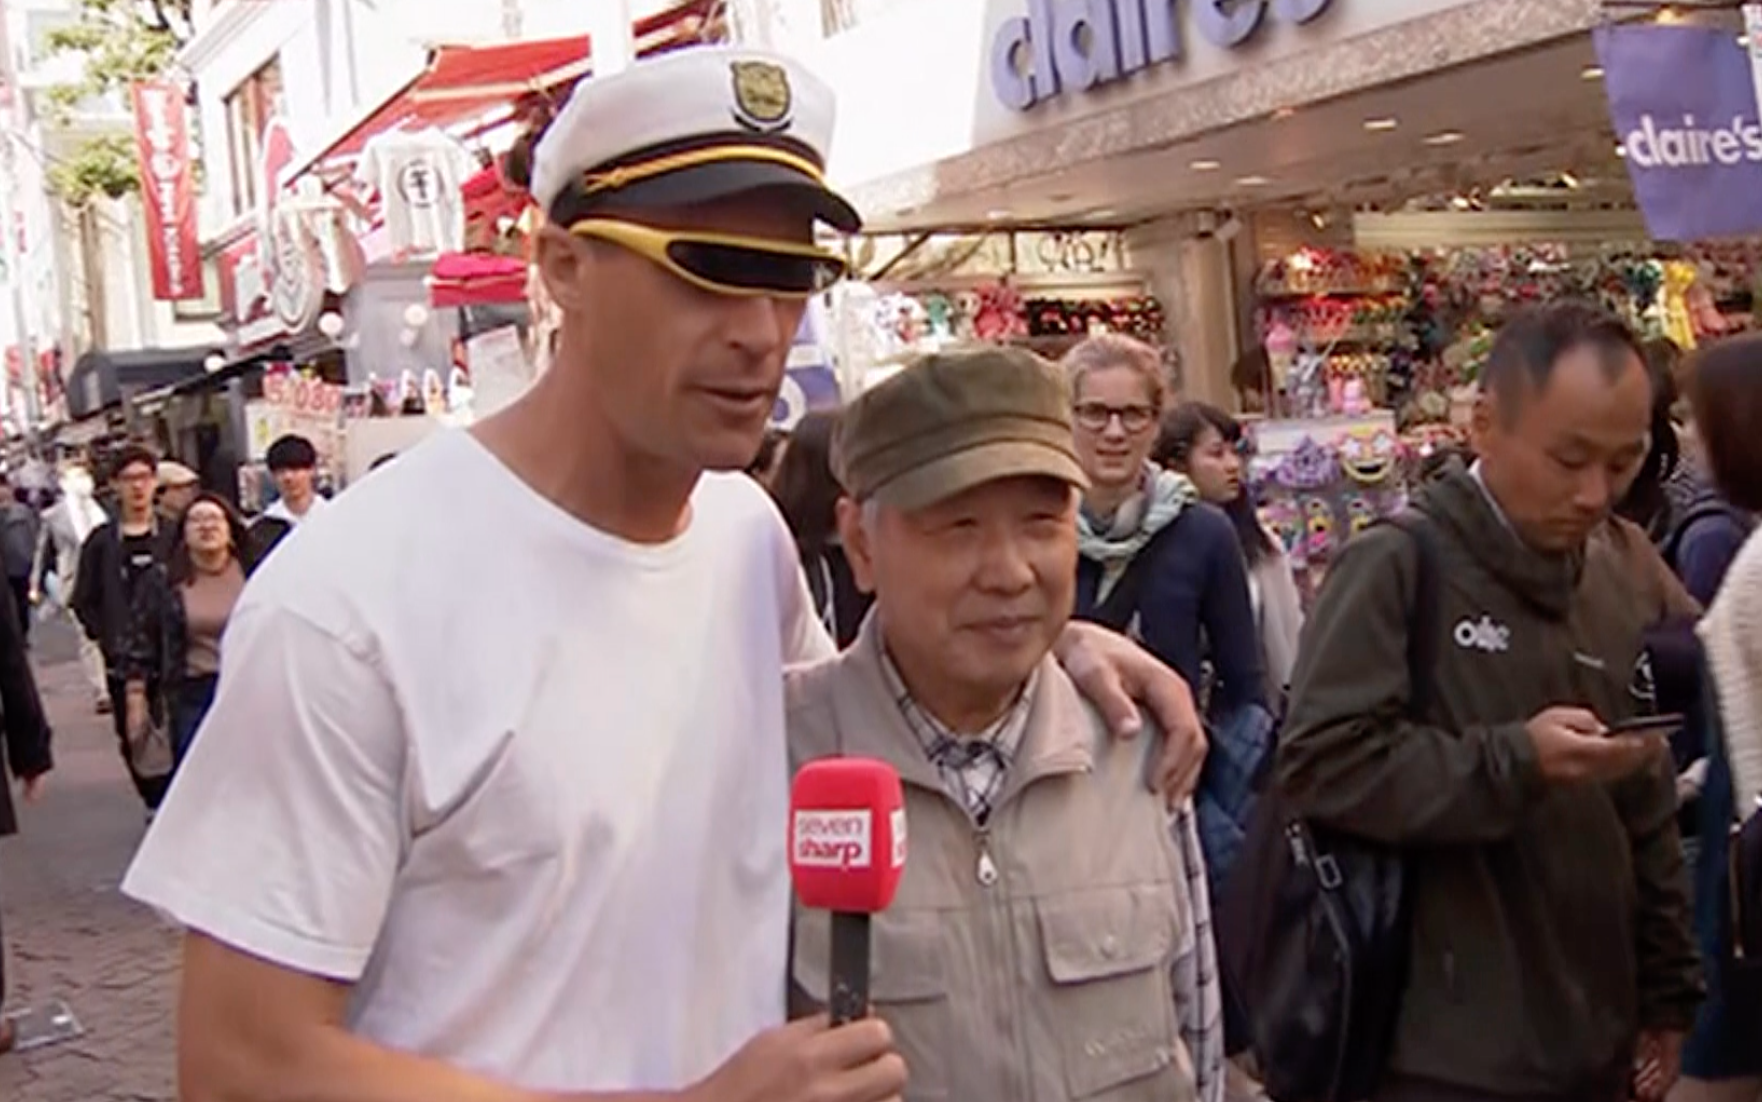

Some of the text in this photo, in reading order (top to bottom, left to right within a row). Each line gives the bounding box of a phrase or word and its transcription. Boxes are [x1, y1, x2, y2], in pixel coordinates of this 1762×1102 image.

[1626, 113, 1762, 166] claire's
[799, 817, 863, 836] seven
[799, 838, 863, 870] sharp
